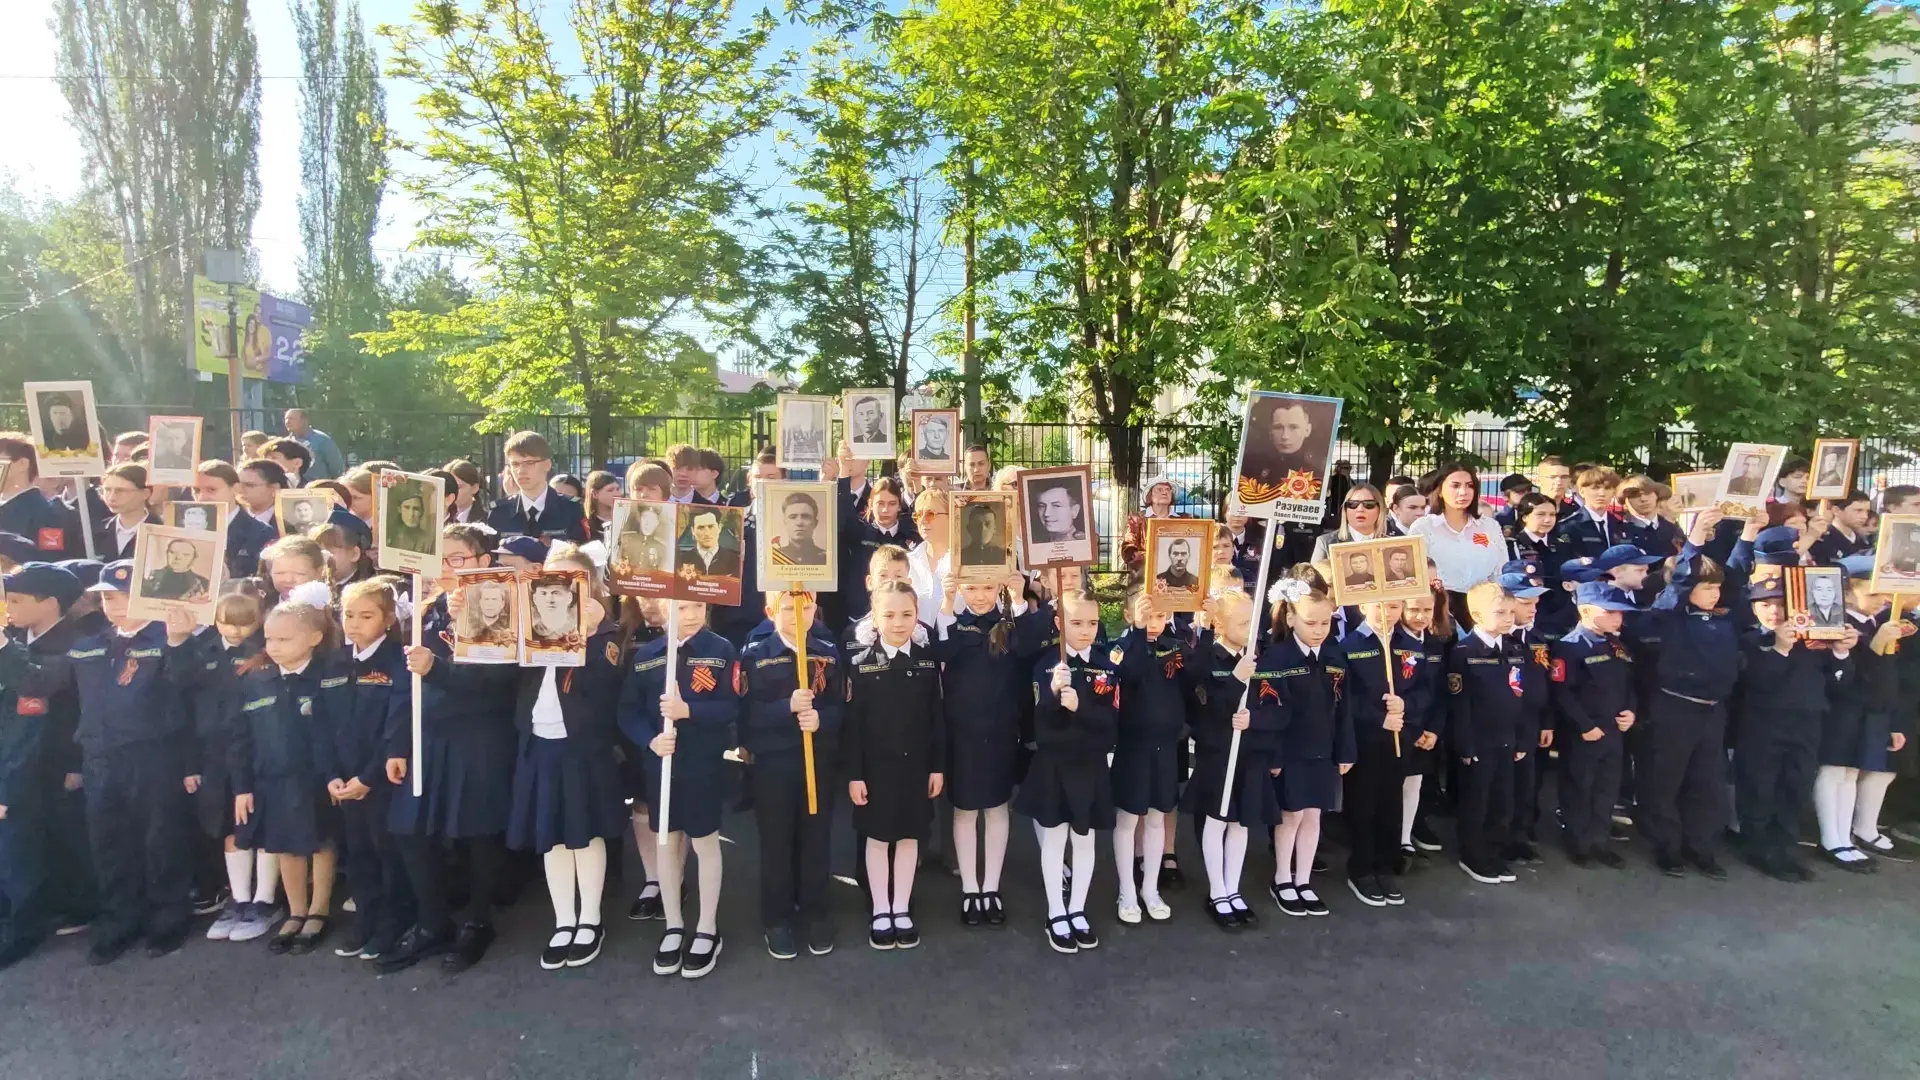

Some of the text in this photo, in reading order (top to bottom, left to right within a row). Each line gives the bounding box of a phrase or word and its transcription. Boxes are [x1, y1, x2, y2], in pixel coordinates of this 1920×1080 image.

[1275, 500, 1320, 514] Разуваев
[1273, 511, 1318, 521] Павел Петрович
